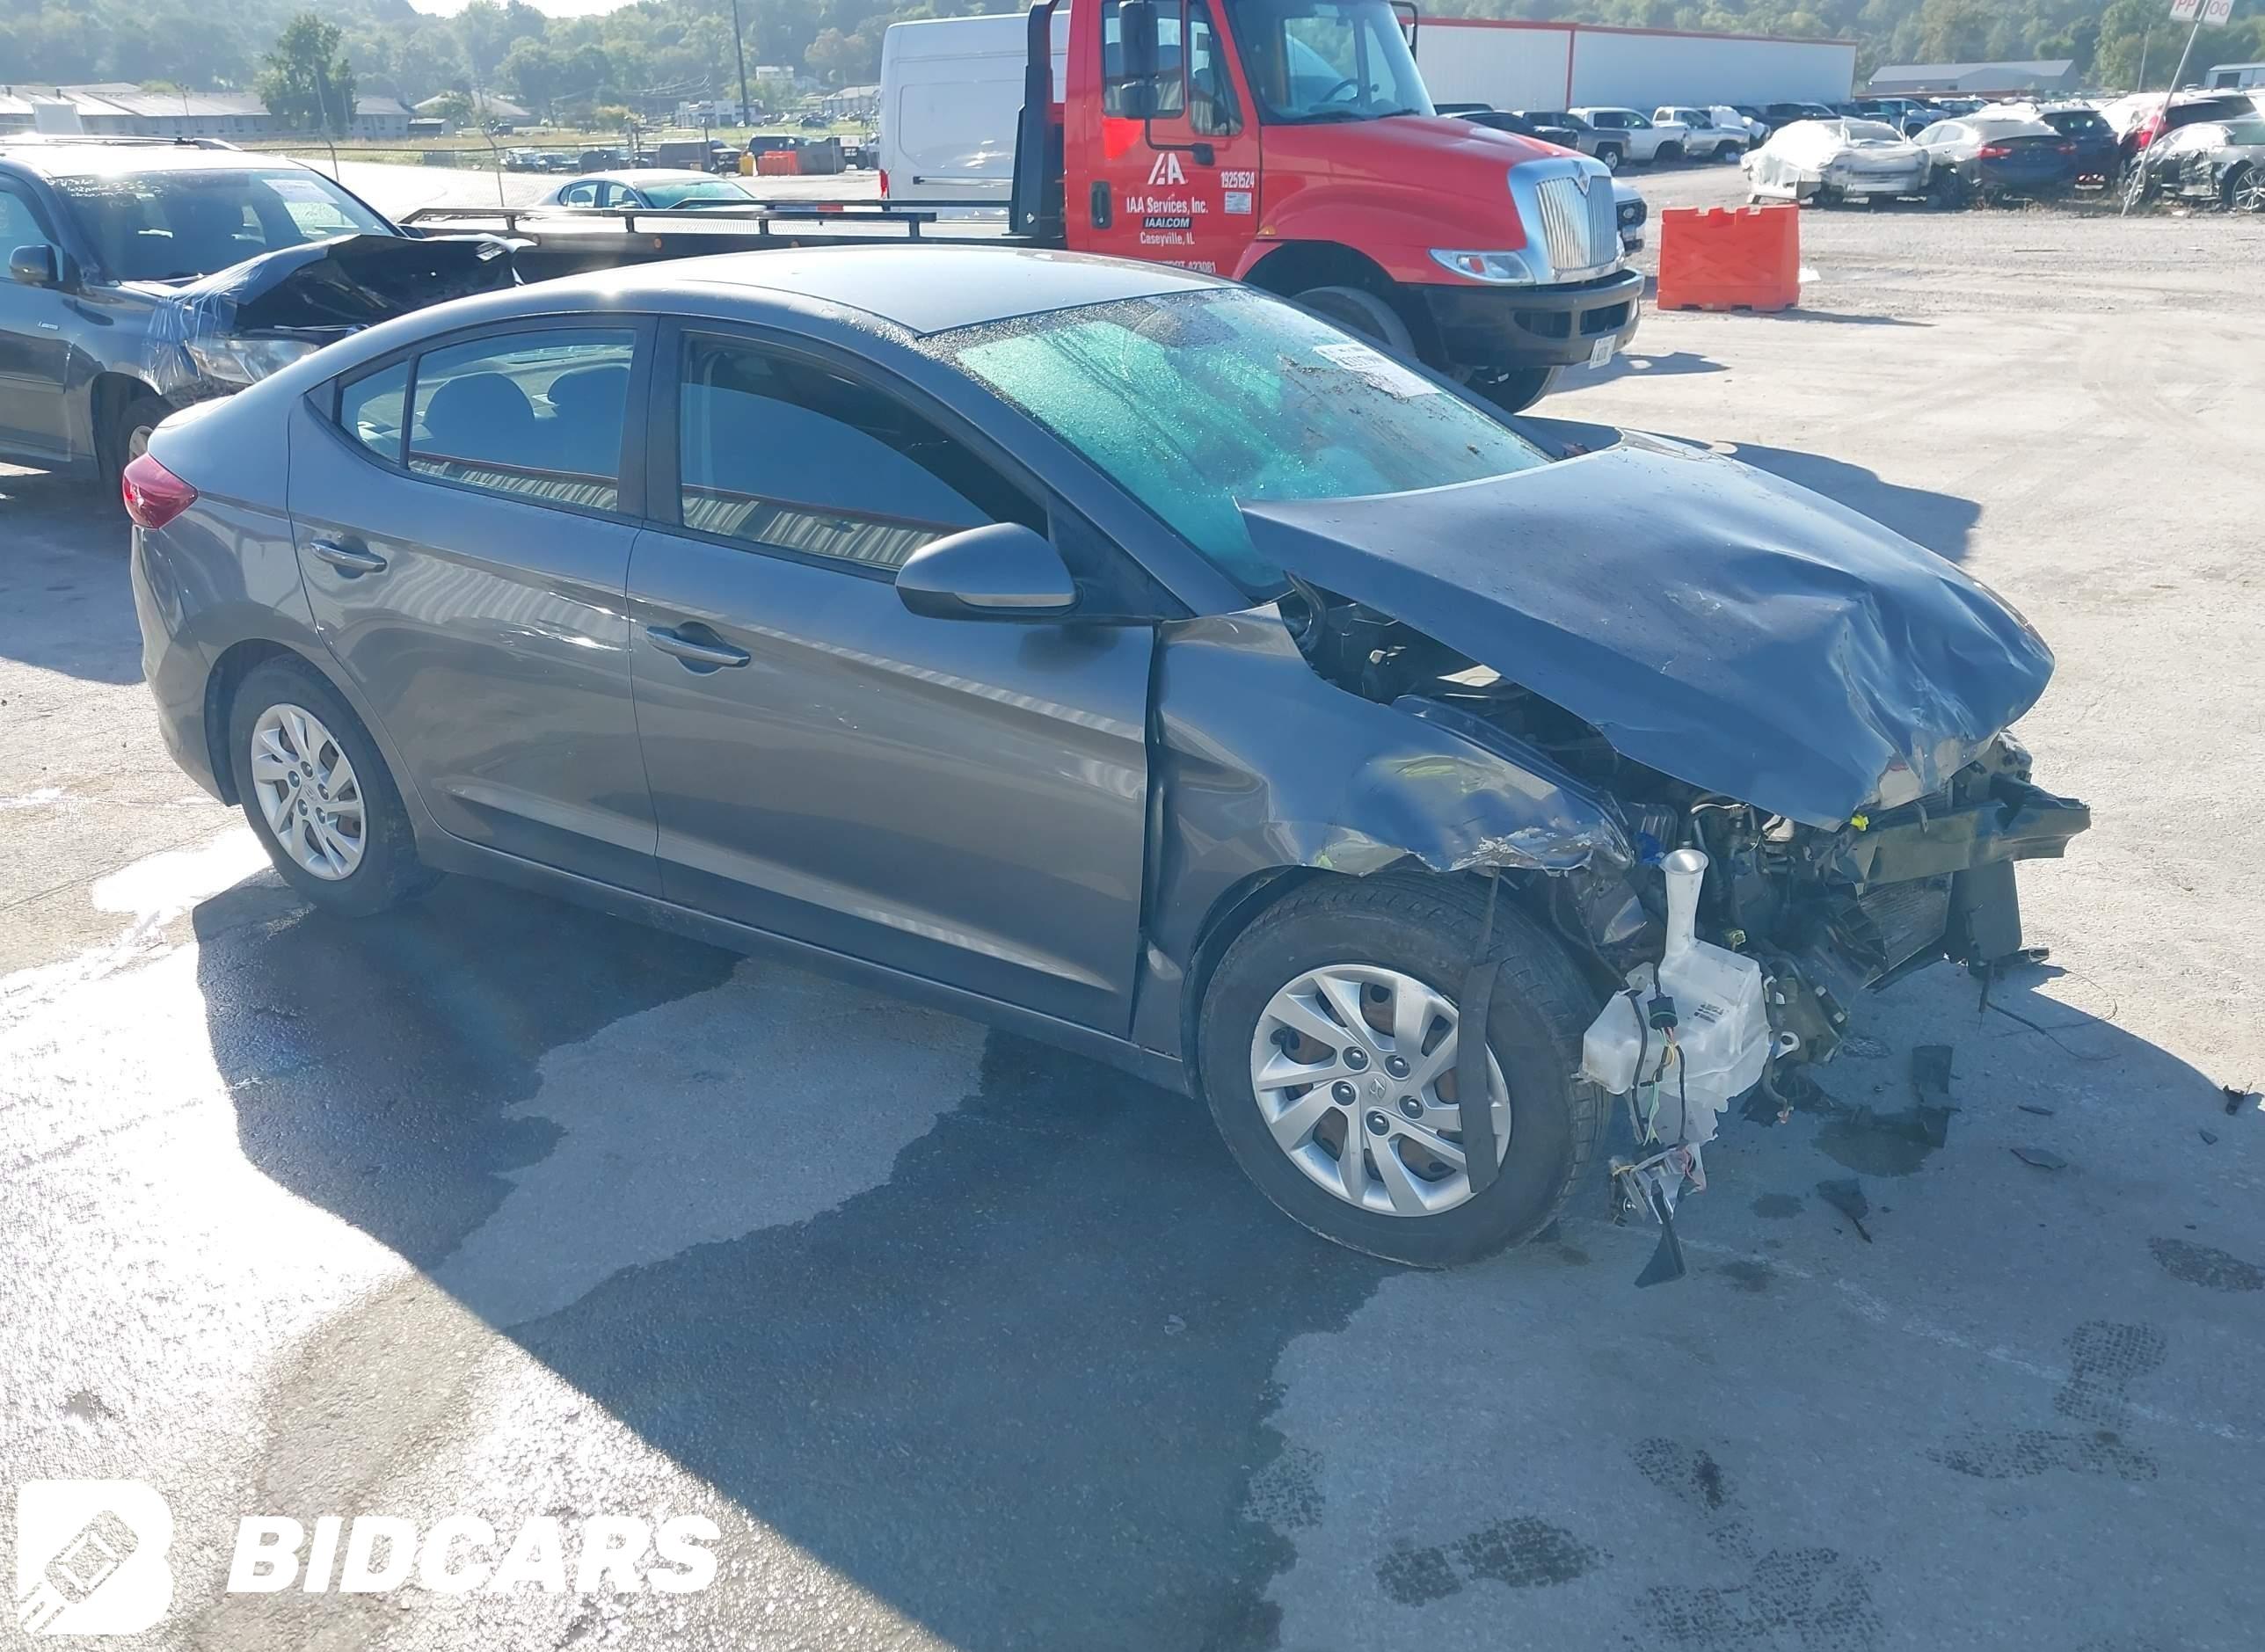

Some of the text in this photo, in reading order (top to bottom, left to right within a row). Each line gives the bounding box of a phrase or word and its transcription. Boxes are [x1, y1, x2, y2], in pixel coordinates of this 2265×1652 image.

[1220, 171, 1255, 188] 19251524
[1126, 196, 1146, 214] IAA
[1147, 196, 1190, 215] Services,
[1191, 196, 1209, 214] Inc.
[1140, 232, 1195, 246] Caseyville, IL
